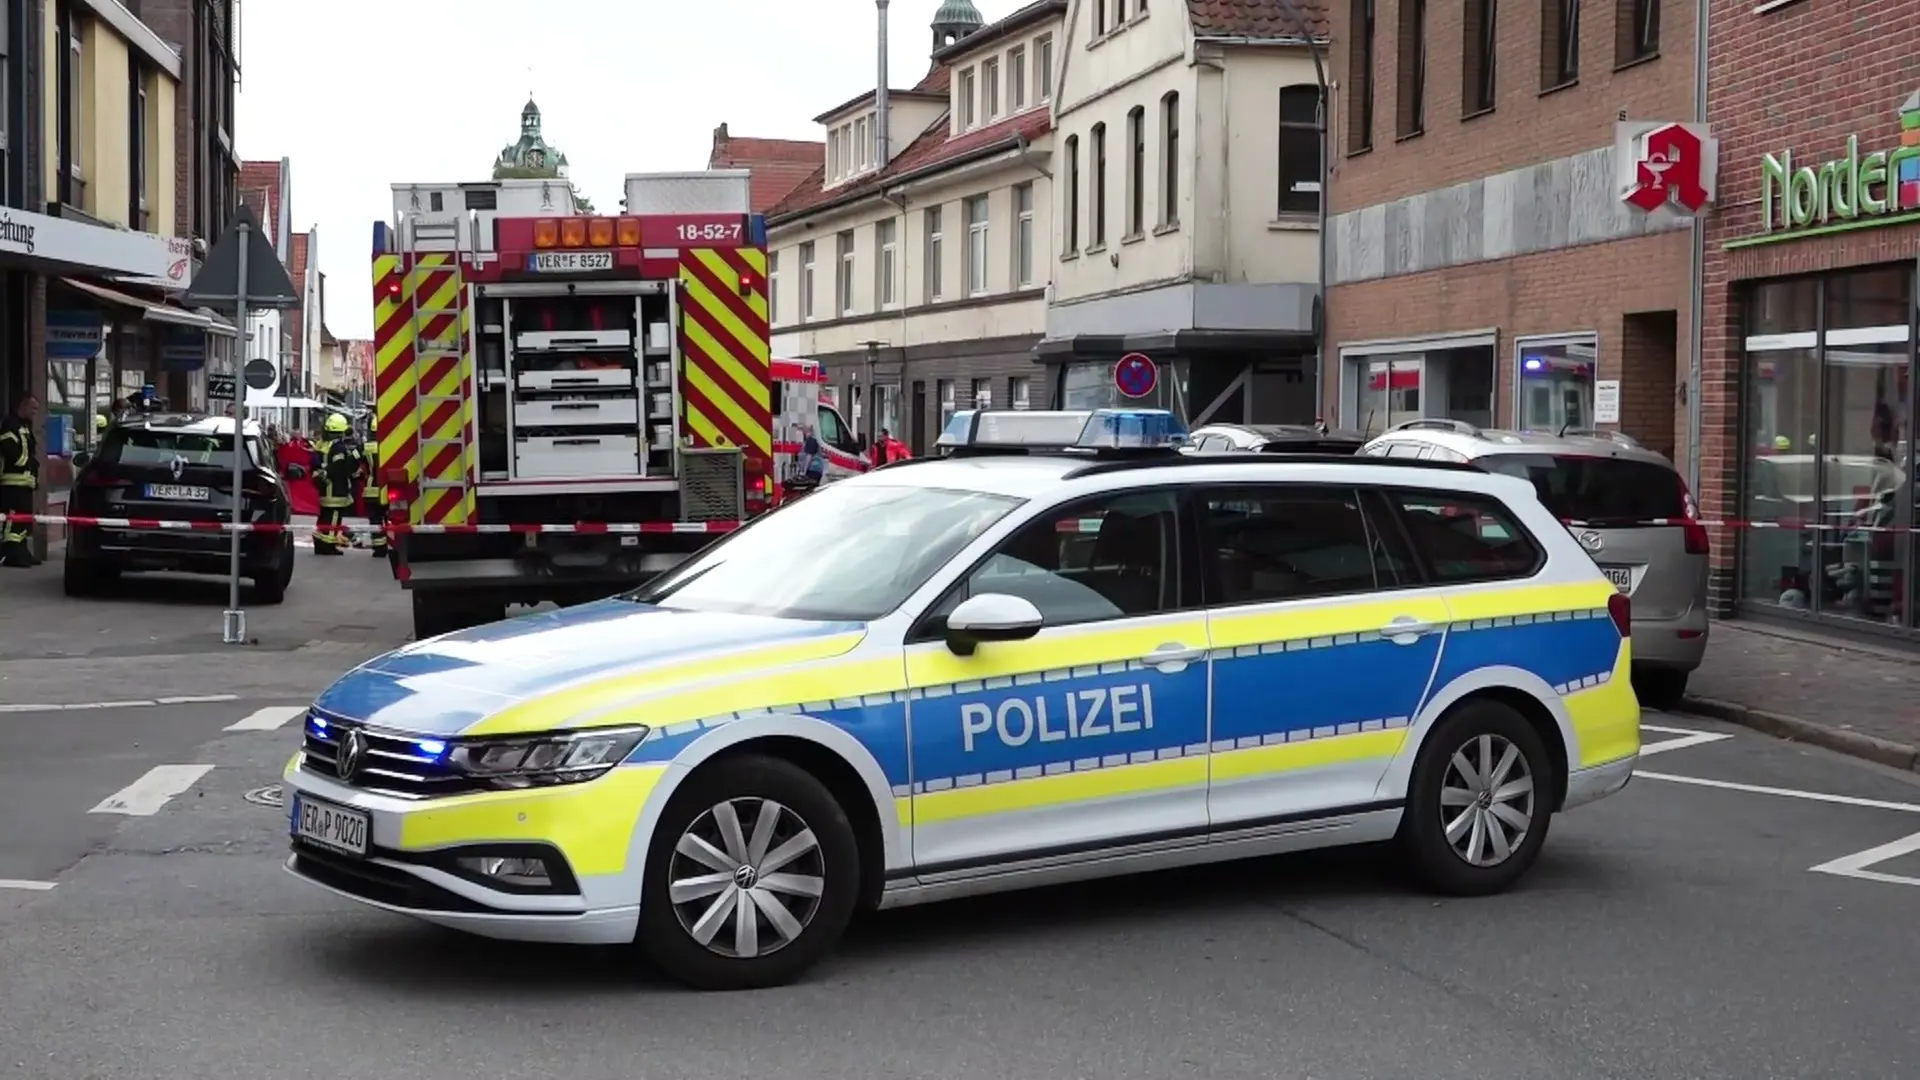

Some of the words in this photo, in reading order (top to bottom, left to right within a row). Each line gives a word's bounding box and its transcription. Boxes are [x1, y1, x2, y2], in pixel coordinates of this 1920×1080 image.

[677, 223, 742, 240] 18-52-7
[538, 254, 561, 269] VER
[569, 254, 577, 268] F
[580, 254, 610, 268] 8527
[960, 684, 1154, 752] POLIZEI
[300, 801, 318, 834] VER
[325, 810, 331, 837] P
[335, 814, 363, 847] 9020
